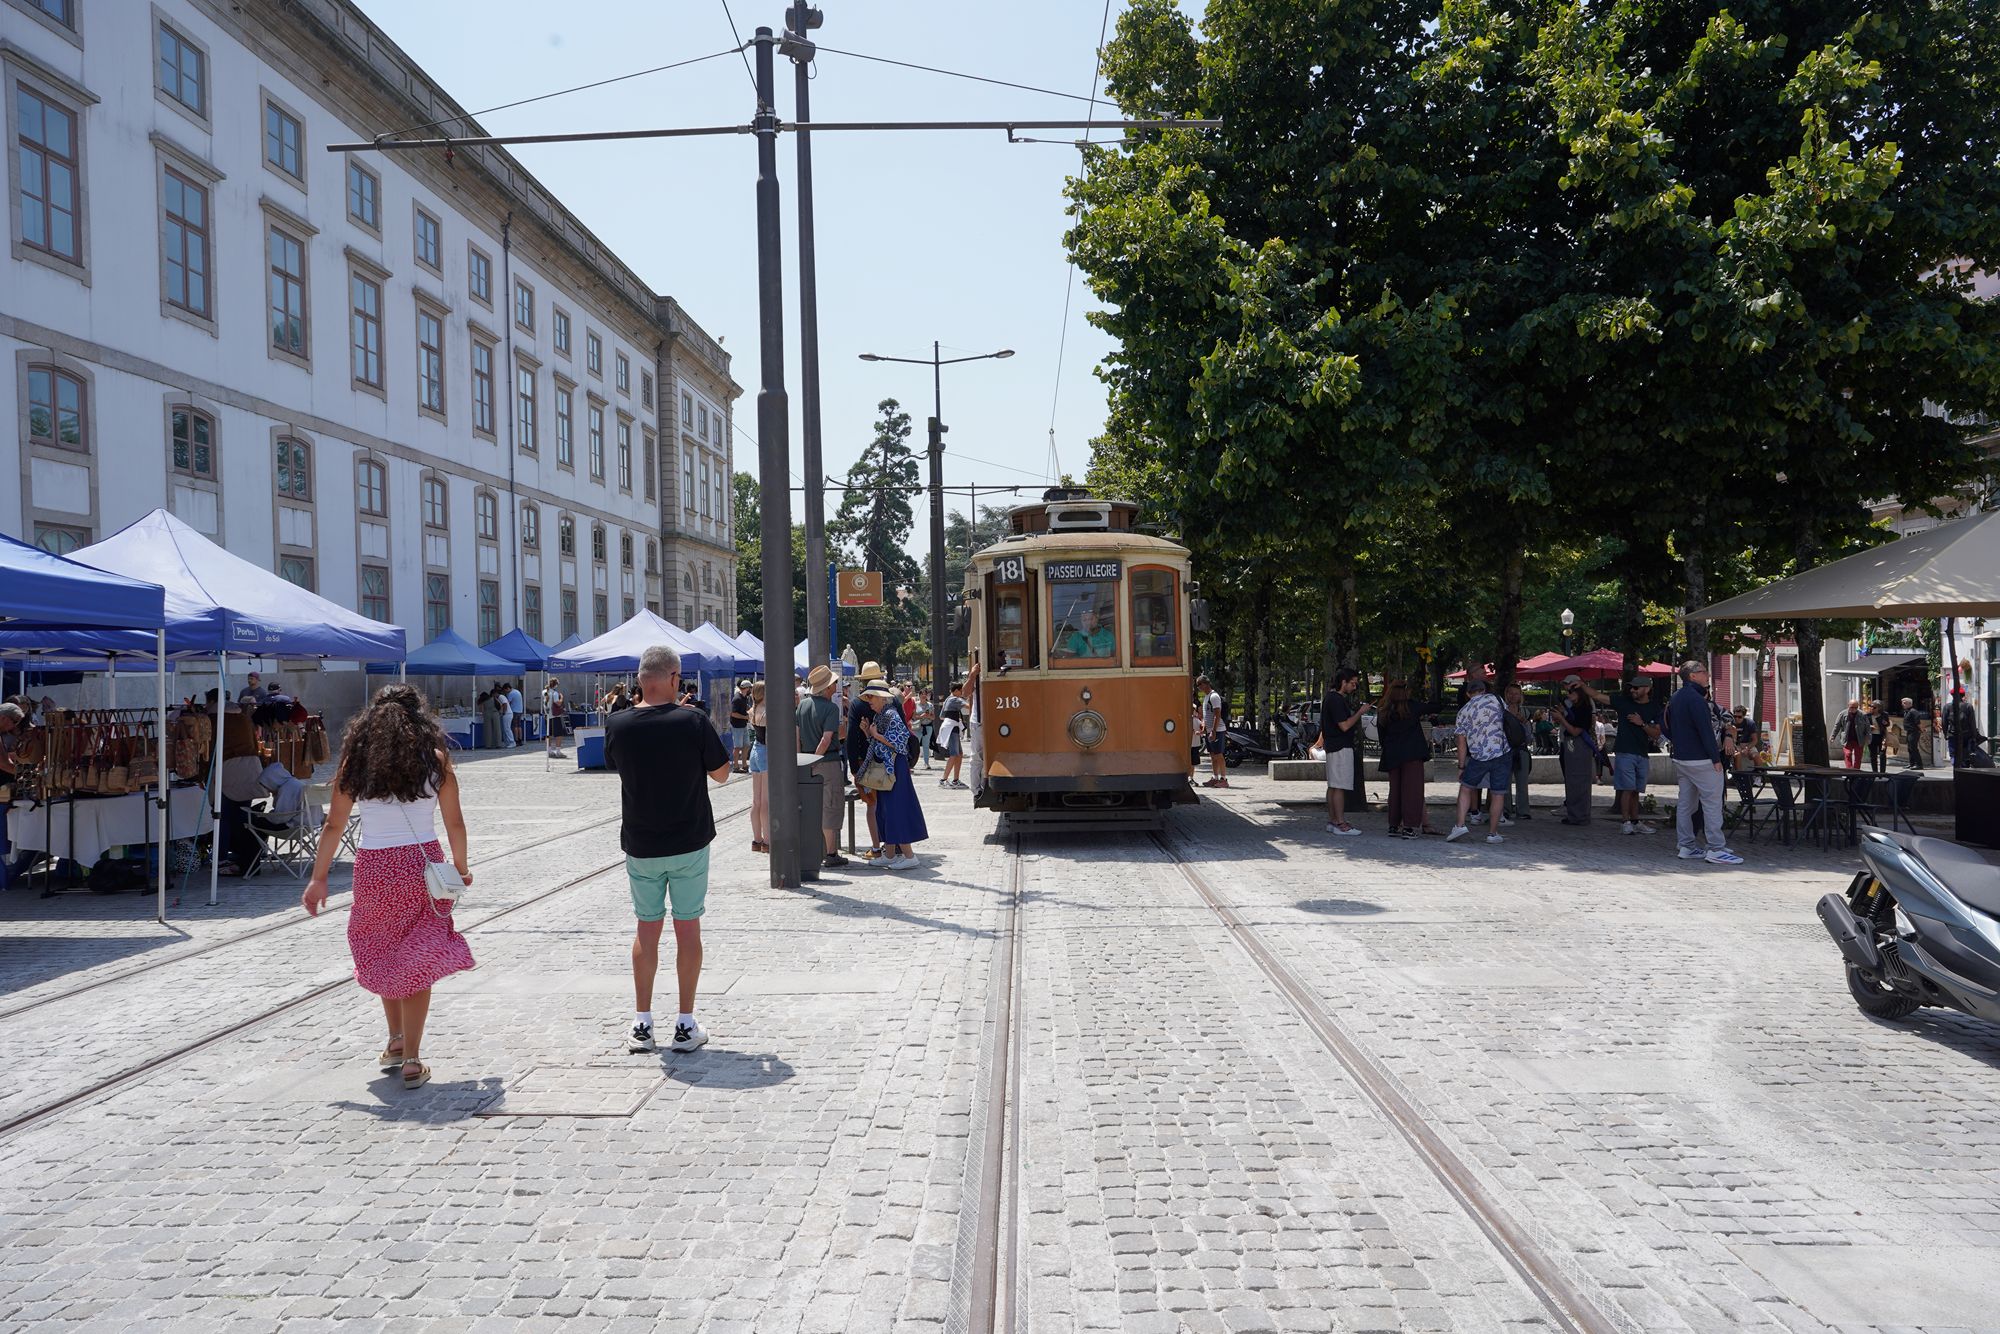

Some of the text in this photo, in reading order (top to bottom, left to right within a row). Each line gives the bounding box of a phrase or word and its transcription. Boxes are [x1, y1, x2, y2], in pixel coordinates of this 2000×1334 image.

[998, 560, 1019, 583] 18
[1048, 563, 1117, 579] PASSEIO ALEGRE
[996, 696, 1020, 709] 218
